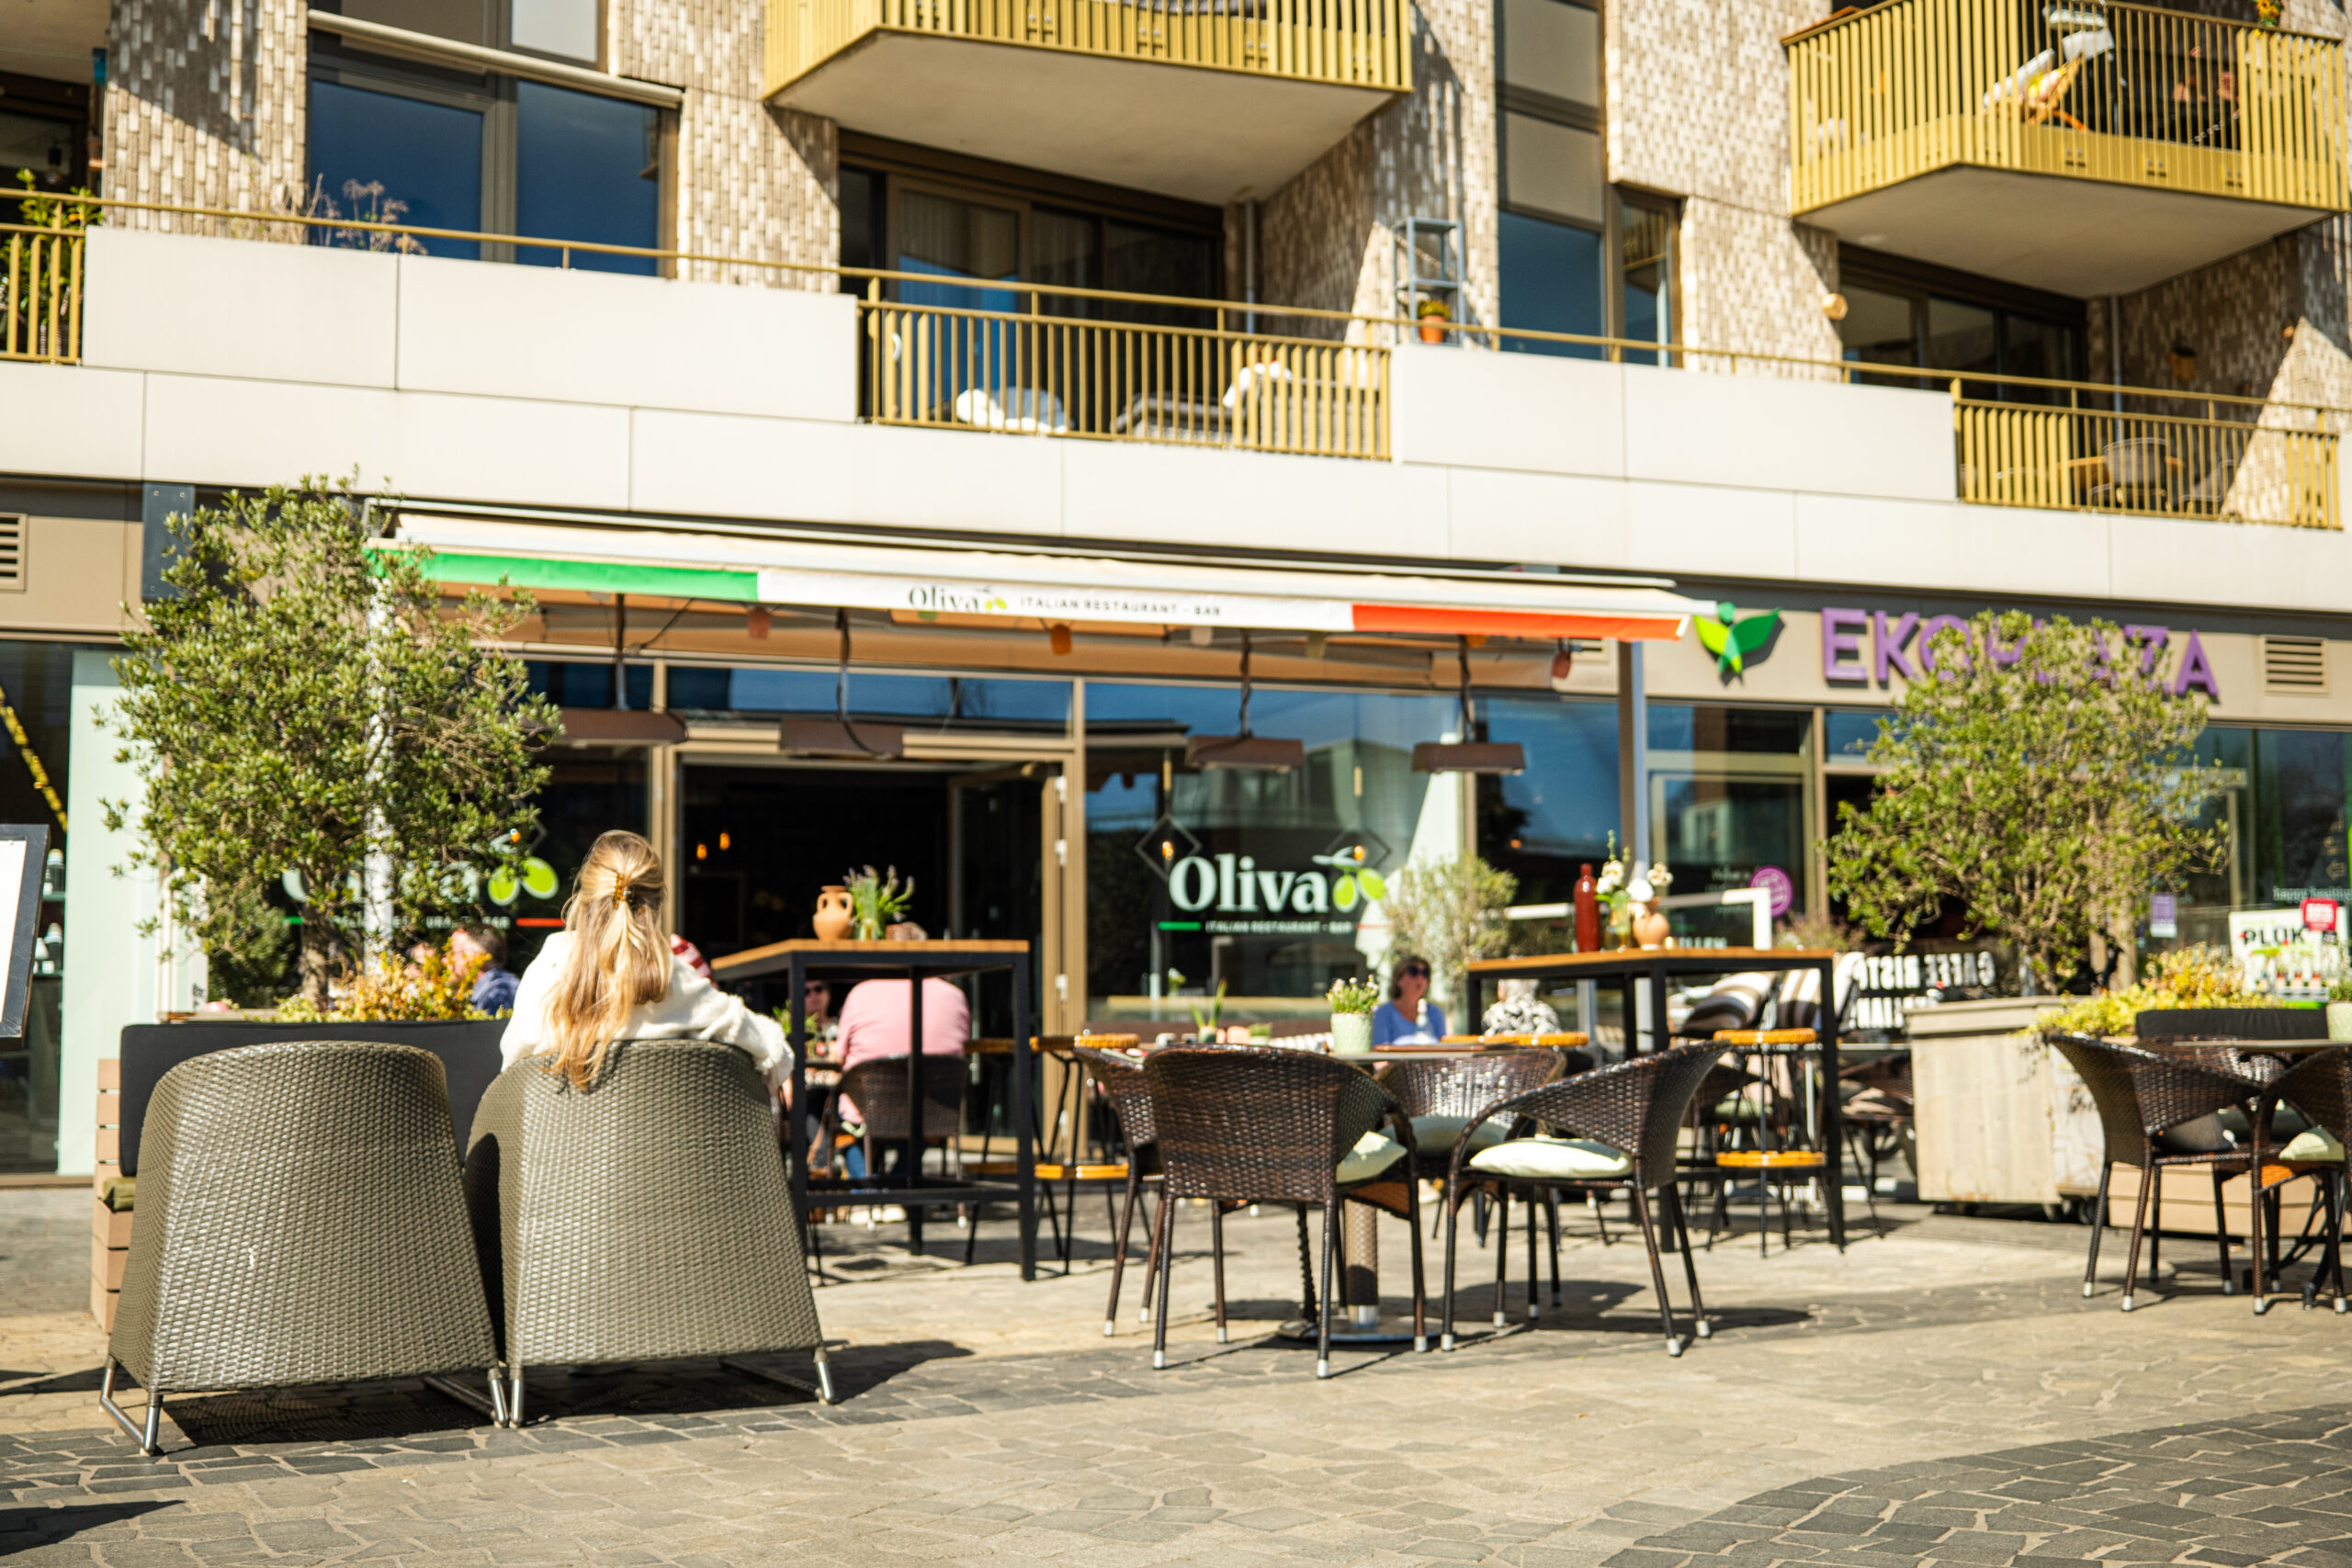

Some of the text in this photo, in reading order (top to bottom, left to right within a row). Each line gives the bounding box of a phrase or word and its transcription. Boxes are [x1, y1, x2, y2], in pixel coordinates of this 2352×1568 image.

[909, 586, 979, 613] Oliva
[1021, 596, 1079, 609] ITALIAN
[1083, 600, 1178, 614] RESTAURANT
[1194, 605, 1221, 616] BAR
[1822, 608, 2219, 696] EKOZA
[1169, 853, 1329, 913] Oliva
[1251, 920, 1320, 934] RESTAURANT
